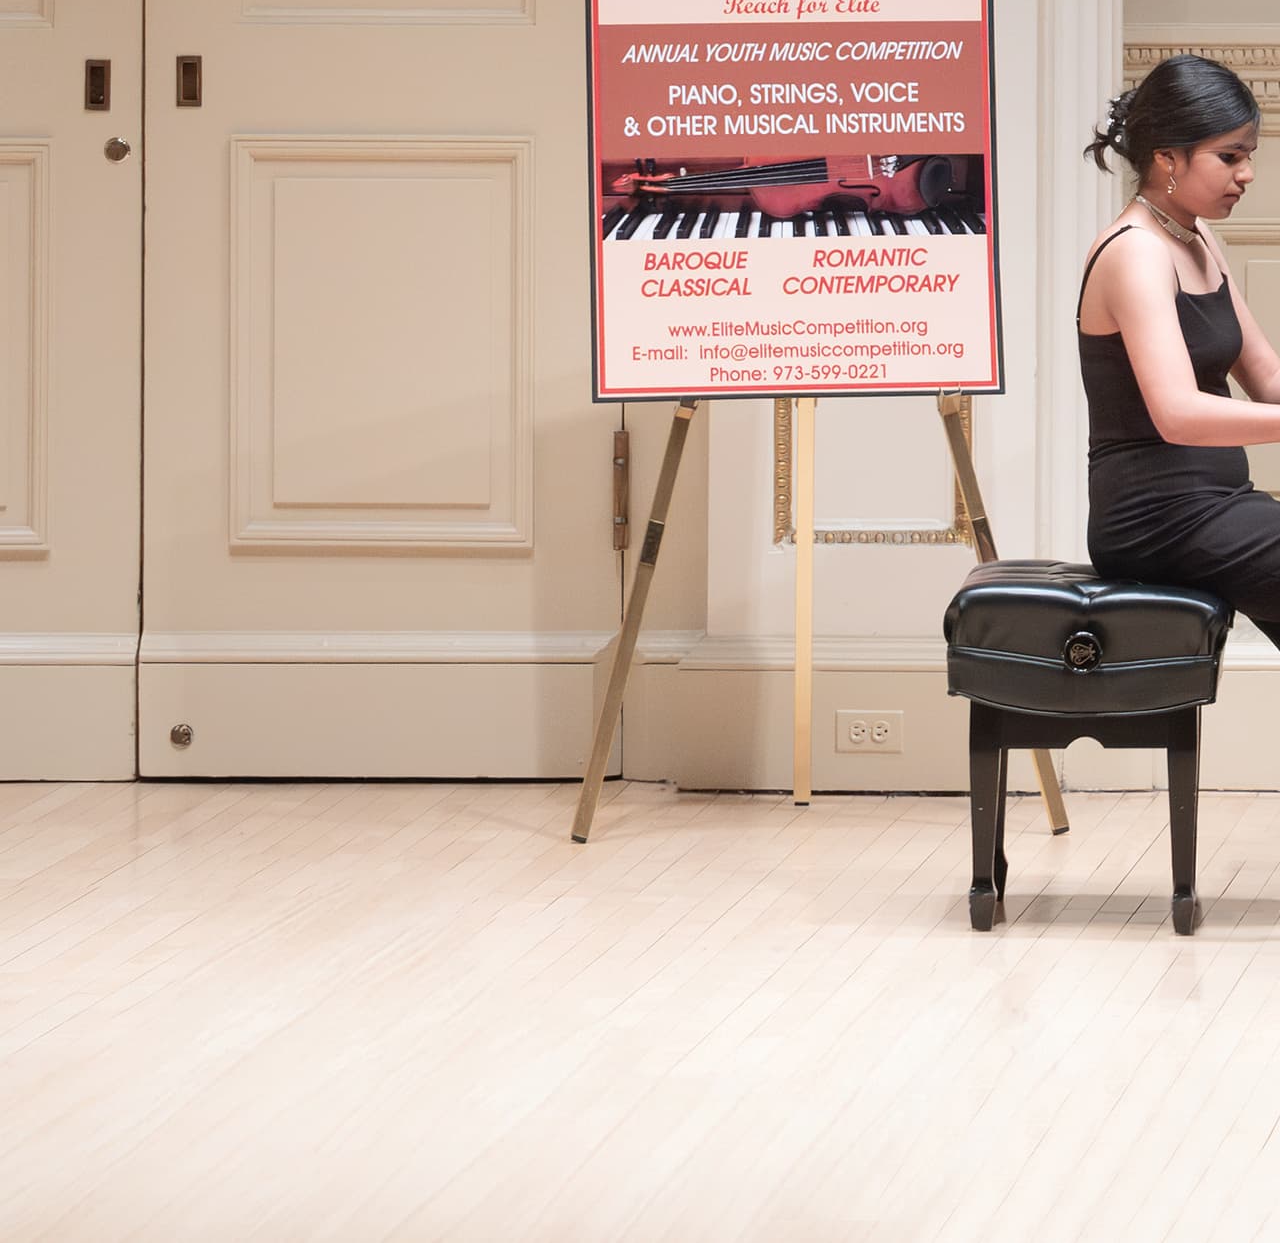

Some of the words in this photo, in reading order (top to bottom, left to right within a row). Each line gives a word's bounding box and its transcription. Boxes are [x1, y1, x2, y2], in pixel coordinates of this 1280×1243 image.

[621, 43, 699, 64] ANNUAL
[705, 42, 765, 63] YOUTH
[768, 41, 833, 62] MUSIC
[835, 40, 964, 61] COMPETITION
[668, 84, 743, 108] PIANO,
[750, 82, 844, 107] STRINGS,
[850, 81, 920, 104] VOICE
[623, 116, 641, 137] &
[646, 115, 718, 137] OTHER
[724, 113, 820, 135] MUSICAL
[825, 112, 966, 134] INSTRUMENTS
[643, 251, 750, 272] BAROQUE
[812, 247, 929, 269] ROMANTIC
[640, 277, 753, 298] CLASSICAL
[782, 273, 961, 296] CONTEMPORARY
[668, 318, 929, 338] www.EliteMusicCompetition.org
[632, 345, 689, 361] E-mail:
[698, 341, 965, 362] info@elitemusiccompetition.org
[710, 366, 768, 383] Phone:
[772, 363, 889, 382] 973-599-0221
